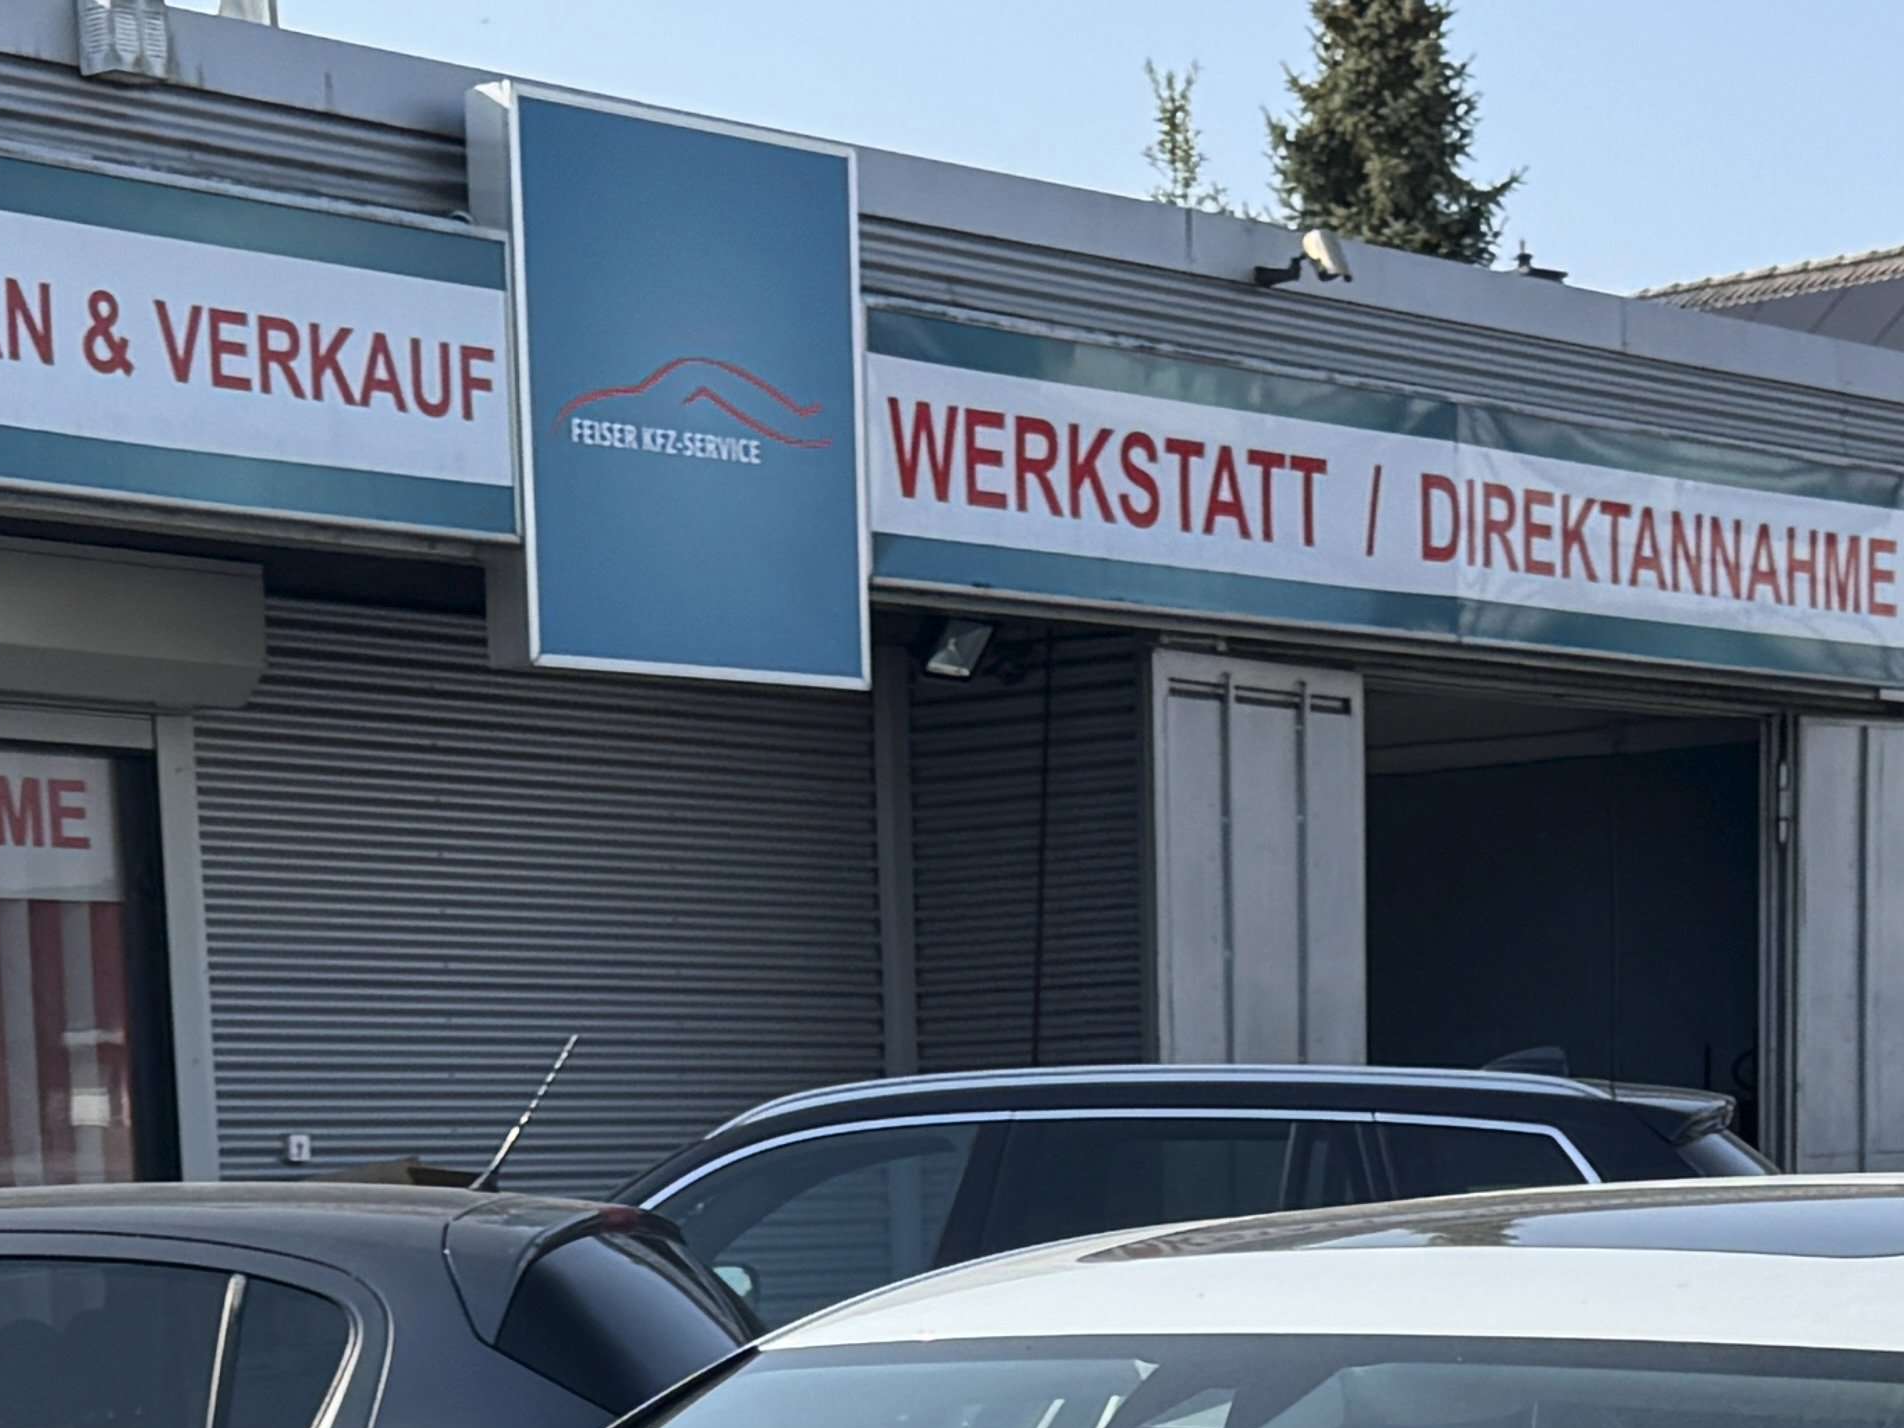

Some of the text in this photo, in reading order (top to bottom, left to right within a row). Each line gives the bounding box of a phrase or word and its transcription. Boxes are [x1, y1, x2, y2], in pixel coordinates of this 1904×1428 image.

[82, 290, 134, 377] &
[154, 299, 495, 421] VERKAUF
[571, 417, 762, 464] FEISER KFZ-SERVICE
[888, 396, 1897, 617] WERKSTATT / DIREKTANNAHME
